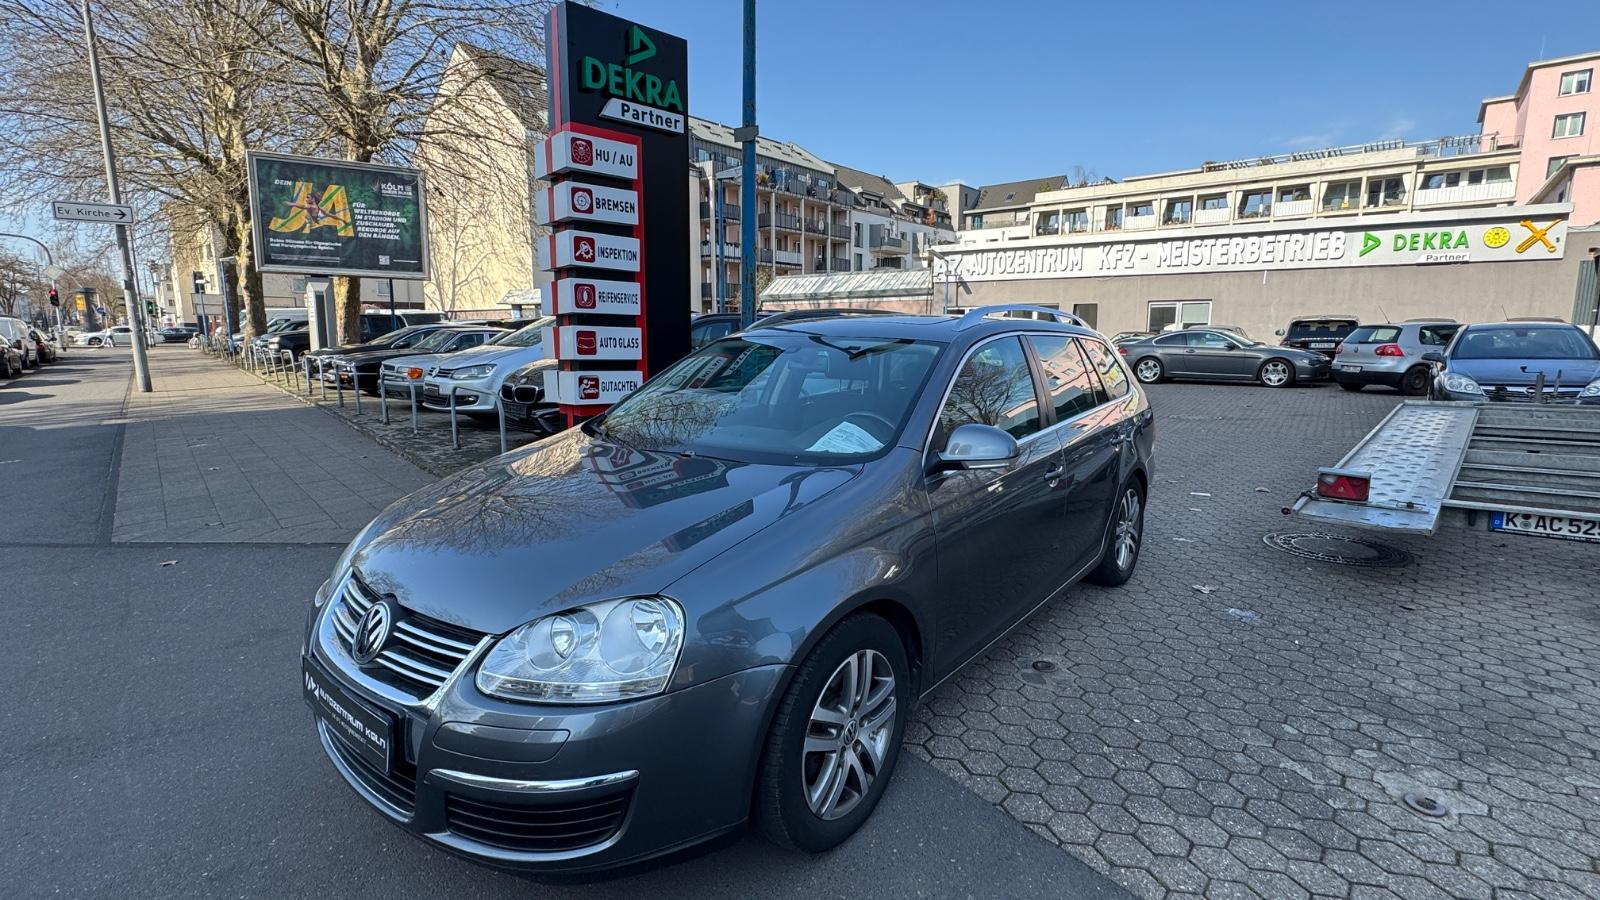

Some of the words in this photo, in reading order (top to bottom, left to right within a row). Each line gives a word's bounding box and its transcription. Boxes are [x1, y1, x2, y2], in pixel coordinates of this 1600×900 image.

[582, 56, 684, 112] DEKRA
[621, 103, 681, 130] Partner
[595, 148, 610, 163] HU
[620, 153, 633, 167] AU
[57, 206, 73, 215] Ev.
[77, 208, 111, 217] Kirche
[268, 181, 355, 237] JA
[353, 209, 401, 217] WELTREKORDE
[595, 197, 635, 214] BREMSEN
[1392, 230, 1469, 252] DEKRA
[597, 247, 638, 262] INSPEKTION
[970, 247, 1083, 276] AUTOZENTRUM
[1098, 243, 1136, 270] KFZ
[1156, 231, 1346, 268] MEISTERBETRIEB
[1426, 253, 1467, 262] Partner
[598, 291, 639, 305] REIFENSERVICE
[601, 380, 638, 392] GUTACHTEN
[1505, 512, 1519, 528] K
[1534, 515, 1564, 532] AC
[1568, 518, 1600, 536] 52
[319, 687, 364, 733] AUTOZENTRUM
